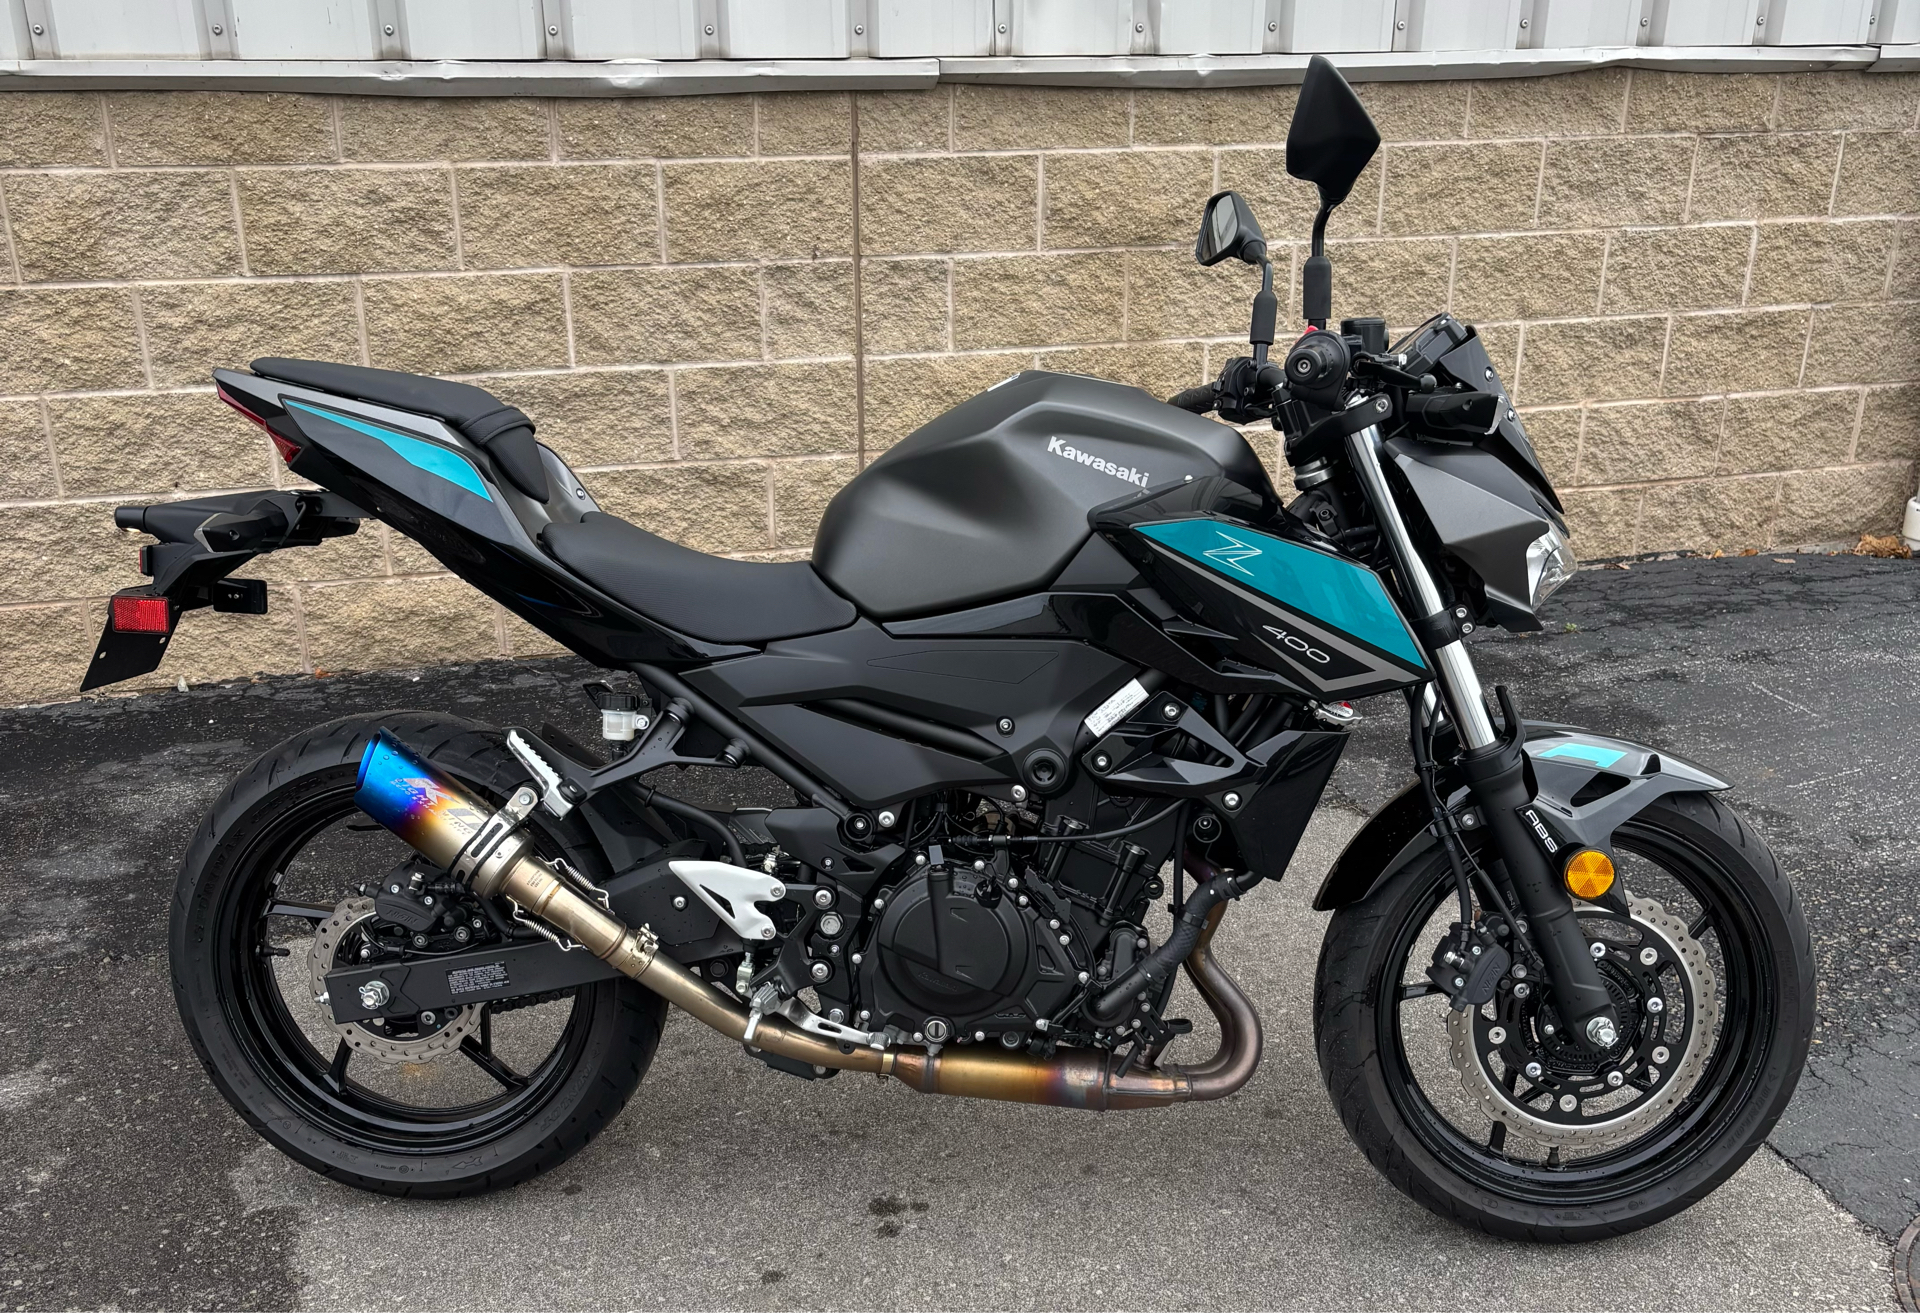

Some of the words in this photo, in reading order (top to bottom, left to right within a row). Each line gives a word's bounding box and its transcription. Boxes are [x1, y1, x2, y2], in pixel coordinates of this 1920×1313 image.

[1047, 435, 1150, 488] Kawasaki
[1202, 530, 1263, 577] Z
[1262, 625, 1331, 663] 400
[1525, 809, 1558, 853] ABS
